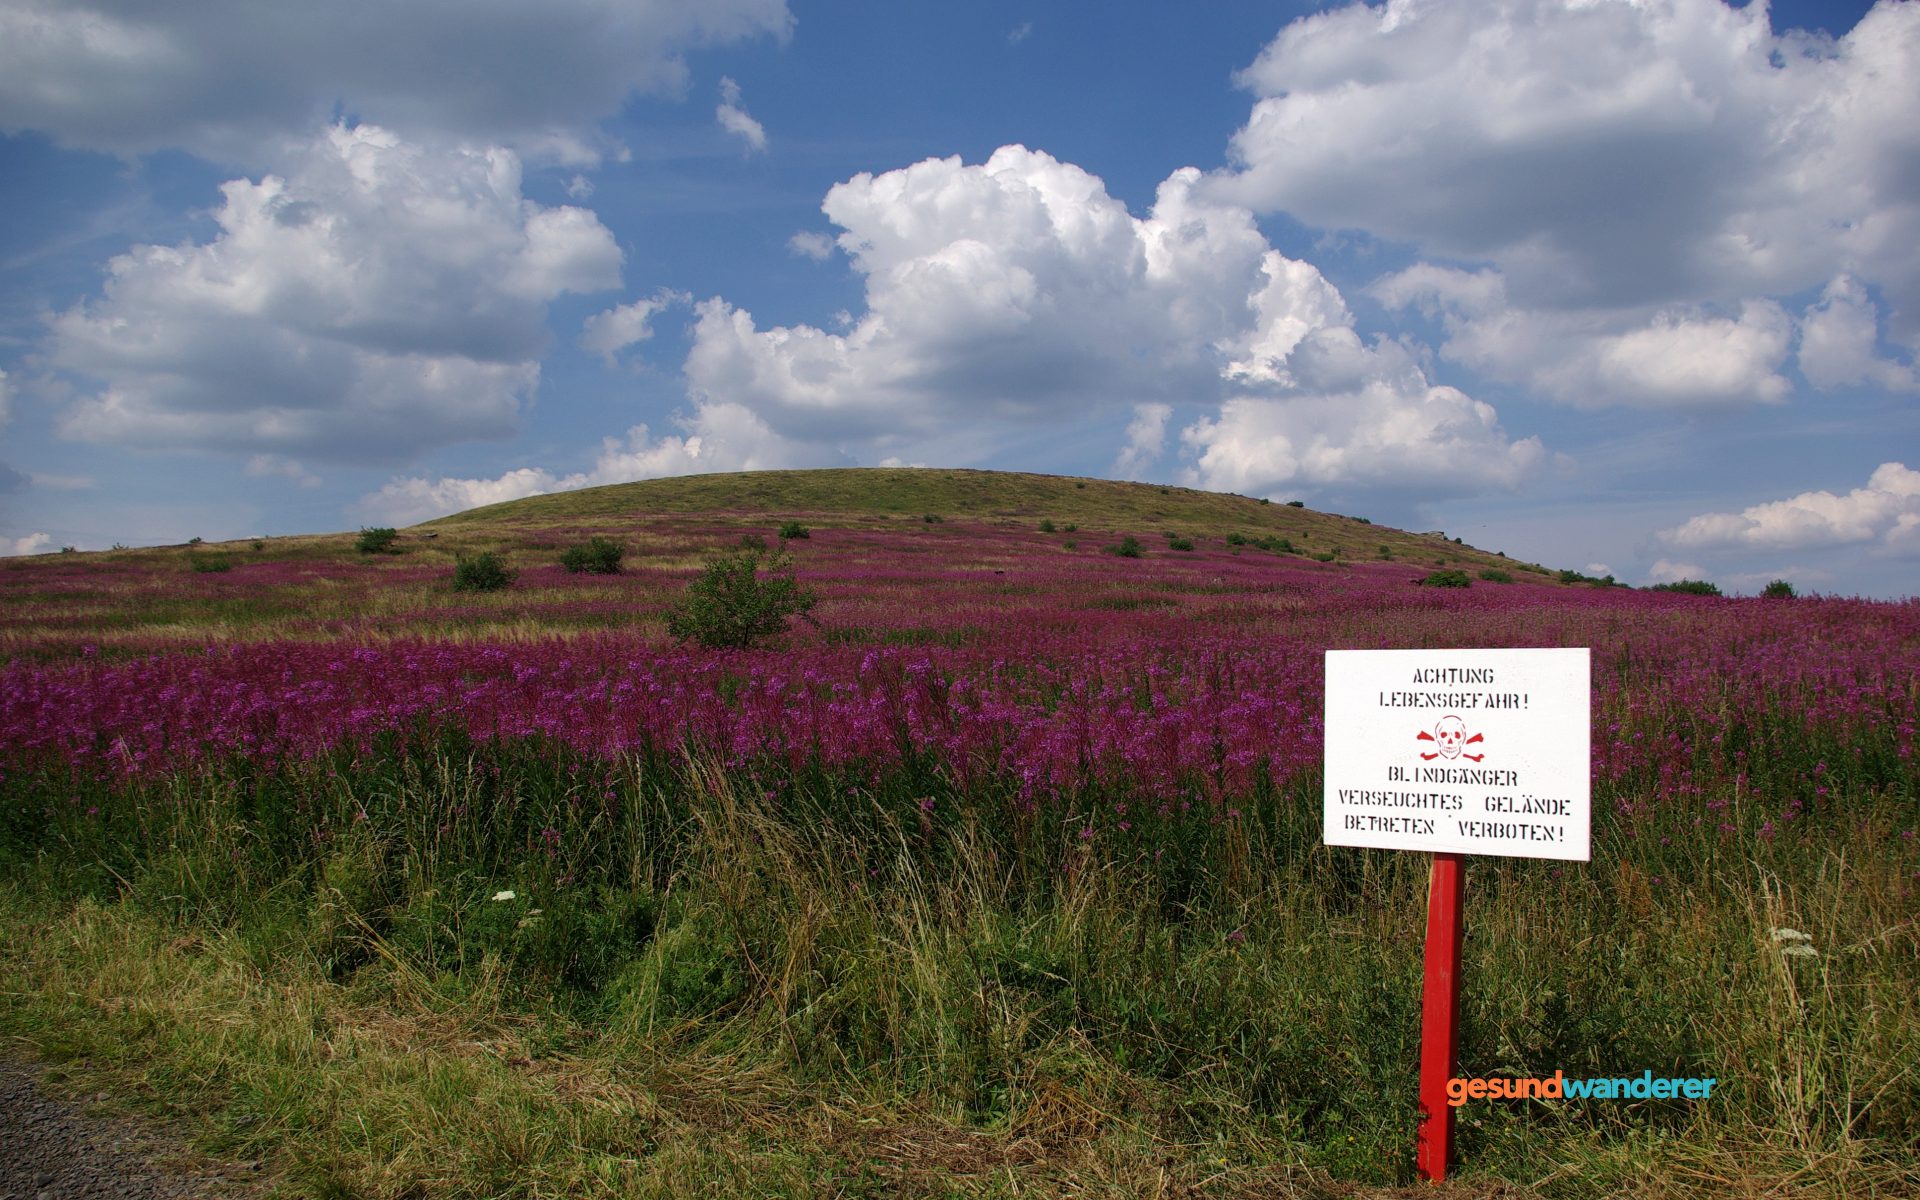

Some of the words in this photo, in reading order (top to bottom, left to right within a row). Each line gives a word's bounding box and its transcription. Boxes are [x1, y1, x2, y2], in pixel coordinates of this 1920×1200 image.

[1413, 668, 1494, 684] ACHTUNG
[1380, 691, 1528, 709] LEBENSGEFAHR!
[1388, 766, 1518, 786] BLINDGÄNGER
[1338, 789, 1463, 810] VERSEUCHTES
[1485, 794, 1571, 815] GELÄNDE
[1345, 814, 1434, 834] BETRETEN
[1458, 820, 1564, 842] VERBOTEN!
